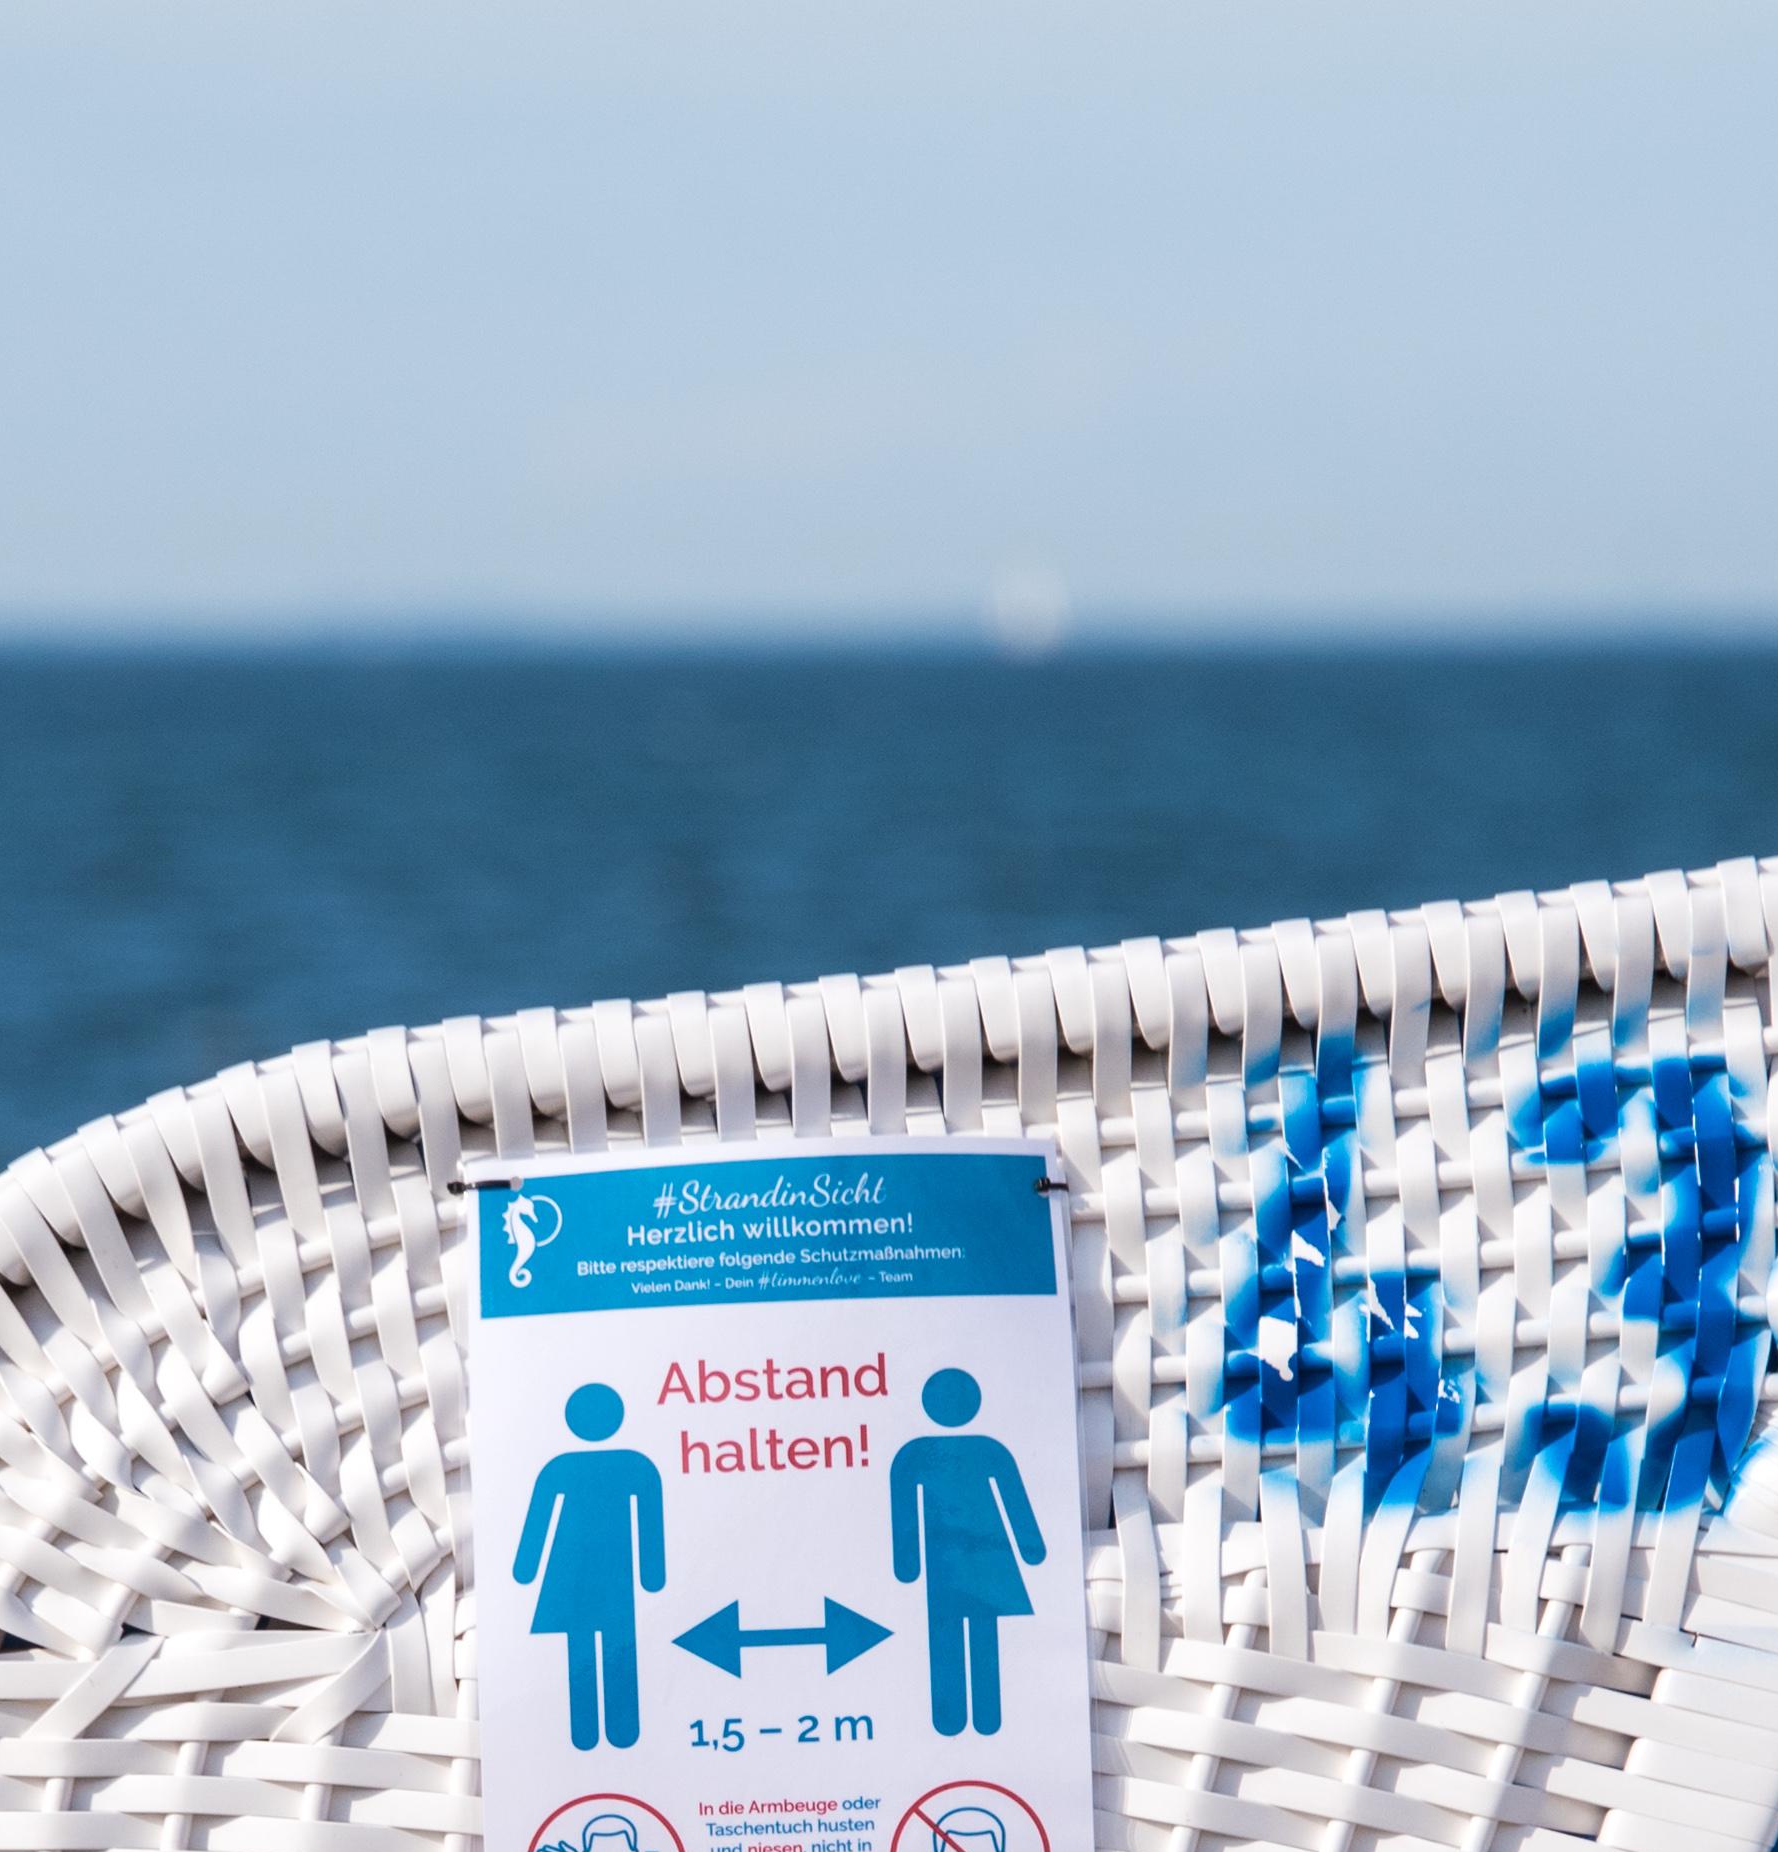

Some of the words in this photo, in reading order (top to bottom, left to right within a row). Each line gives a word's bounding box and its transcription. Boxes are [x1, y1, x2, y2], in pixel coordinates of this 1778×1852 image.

[653, 1172, 886, 1219] #StrandinSicht
[627, 1219, 735, 1247] Herzlich
[743, 1212, 913, 1240] willkommen!
[577, 1260, 617, 1277] Bitte
[621, 1255, 715, 1275] respektiere
[719, 1249, 796, 1270] folgende
[800, 1244, 966, 1264] Schutzmaßnahmen:
[1220, 1030, 1764, 1513] 43
[631, 1281, 672, 1294] Vielen
[674, 1279, 711, 1292] Dank!
[725, 1277, 754, 1289] Dein
[879, 1271, 913, 1283] Team
[657, 1352, 888, 1406] Abstand
[681, 1425, 871, 1474] halten!
[689, 1717, 745, 1752] 1,5
[797, 1715, 821, 1744] 2
[834, 1714, 874, 1742] m
[699, 1802, 714, 1816] In
[718, 1801, 744, 1815] die
[748, 1798, 838, 1815] Armbeuge
[842, 1796, 881, 1810] oder
[706, 1819, 813, 1837] Taschentuch
[818, 1818, 874, 1833] husten
[857, 1838, 872, 1852] in
